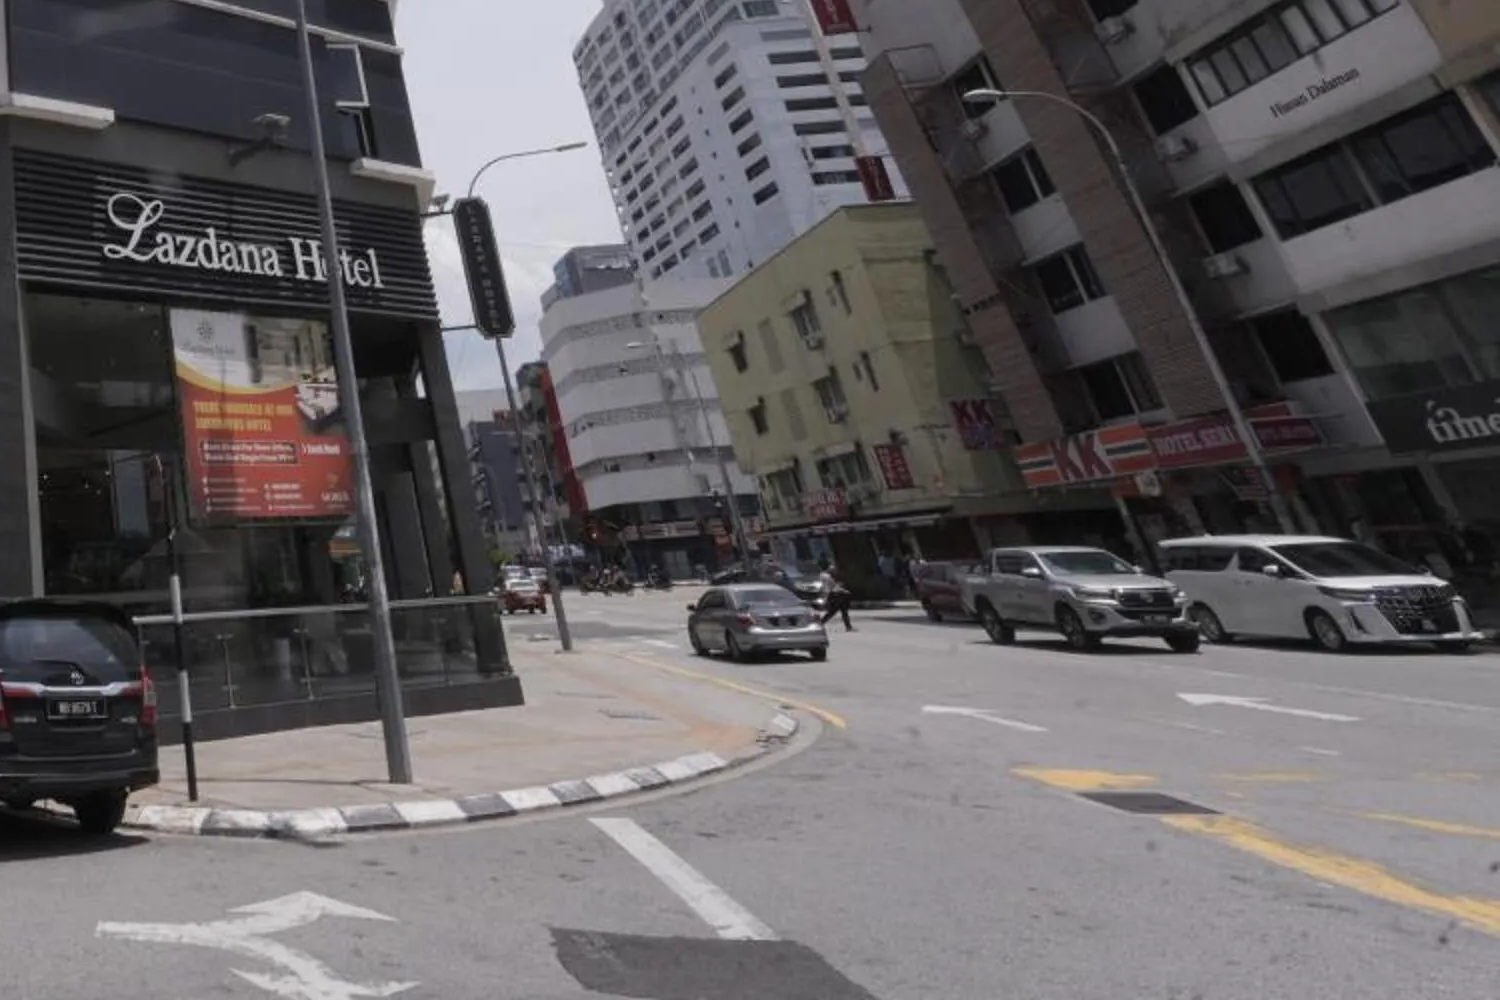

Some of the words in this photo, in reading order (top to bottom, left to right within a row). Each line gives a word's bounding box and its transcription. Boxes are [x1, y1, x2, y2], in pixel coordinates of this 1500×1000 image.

[103, 193, 284, 278] Lazdana
[1048, 434, 1112, 481] KK
[1153, 432, 1203, 457] HOTEL
